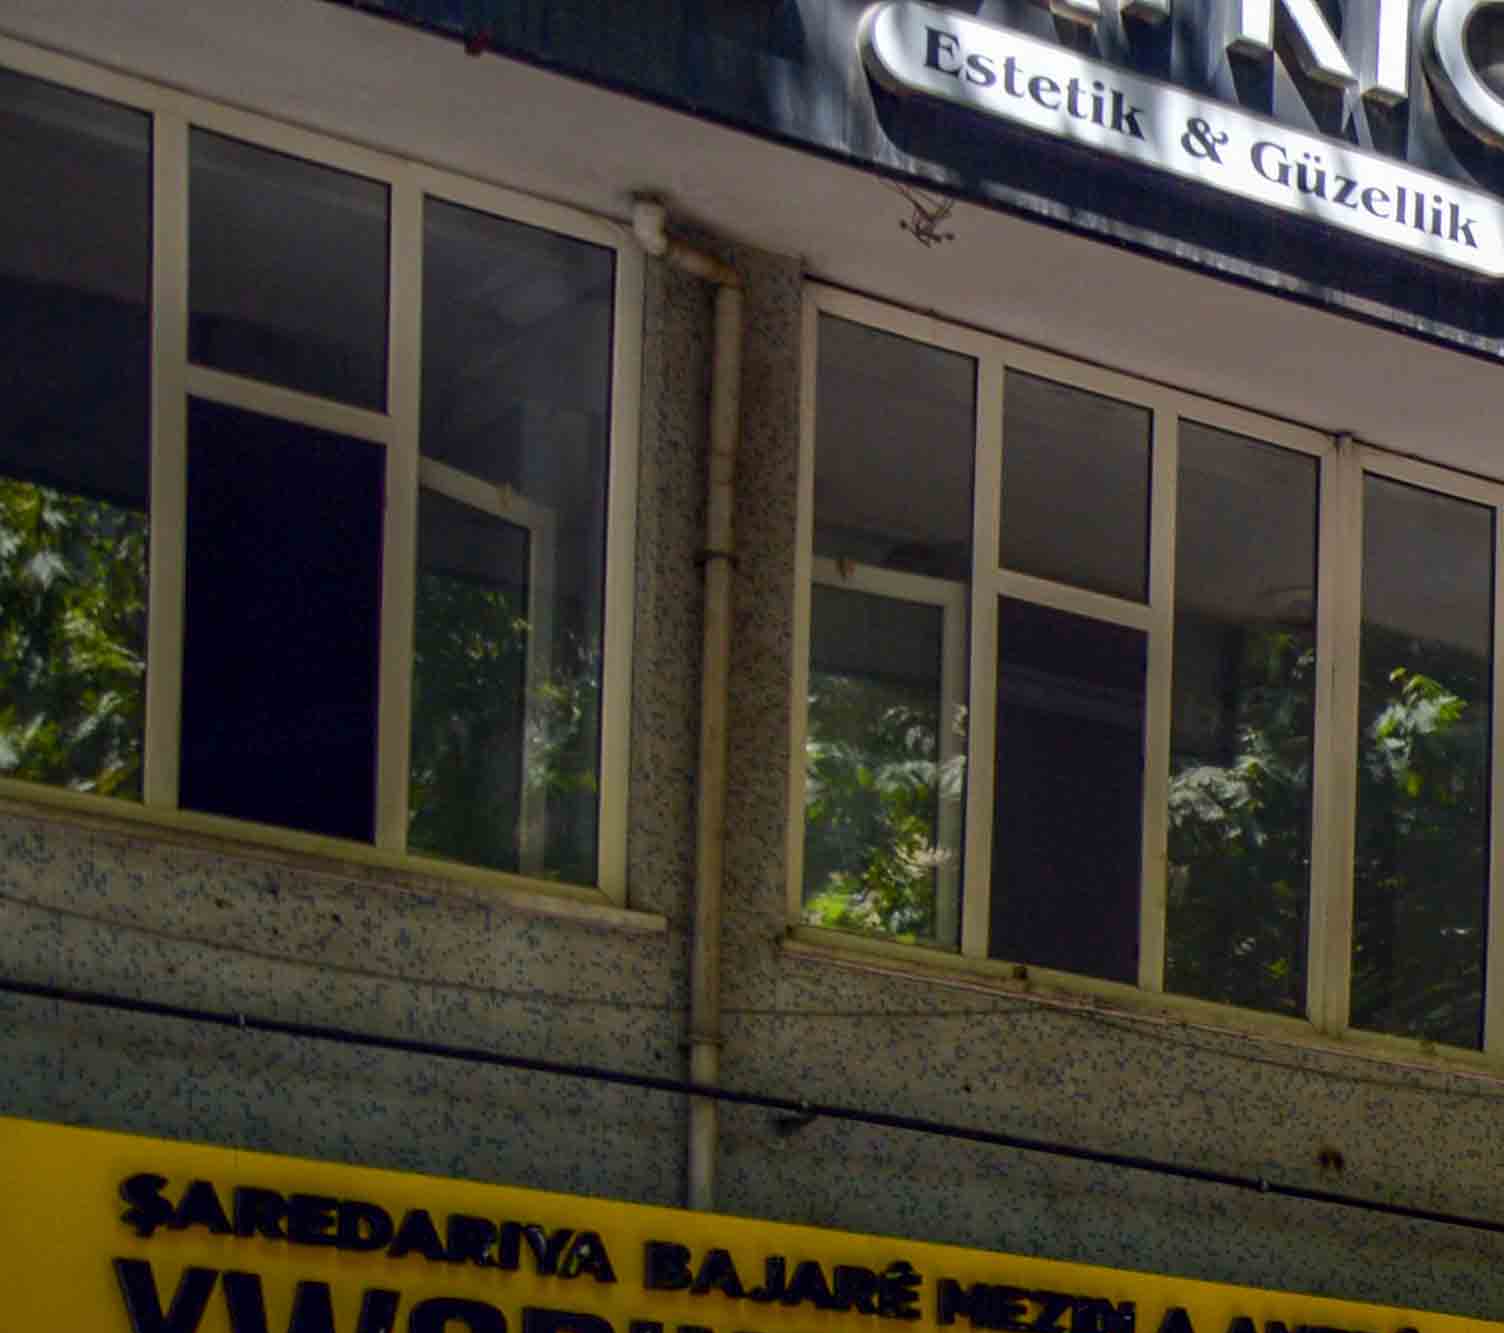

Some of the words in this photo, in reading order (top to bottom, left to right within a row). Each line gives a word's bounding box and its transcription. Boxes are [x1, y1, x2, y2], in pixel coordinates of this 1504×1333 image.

[922, 24, 1144, 141] Estetik
[1181, 114, 1230, 166] &
[1249, 138, 1481, 250] Güzellik
[641, 1238, 925, 1322] BAJARÊ
